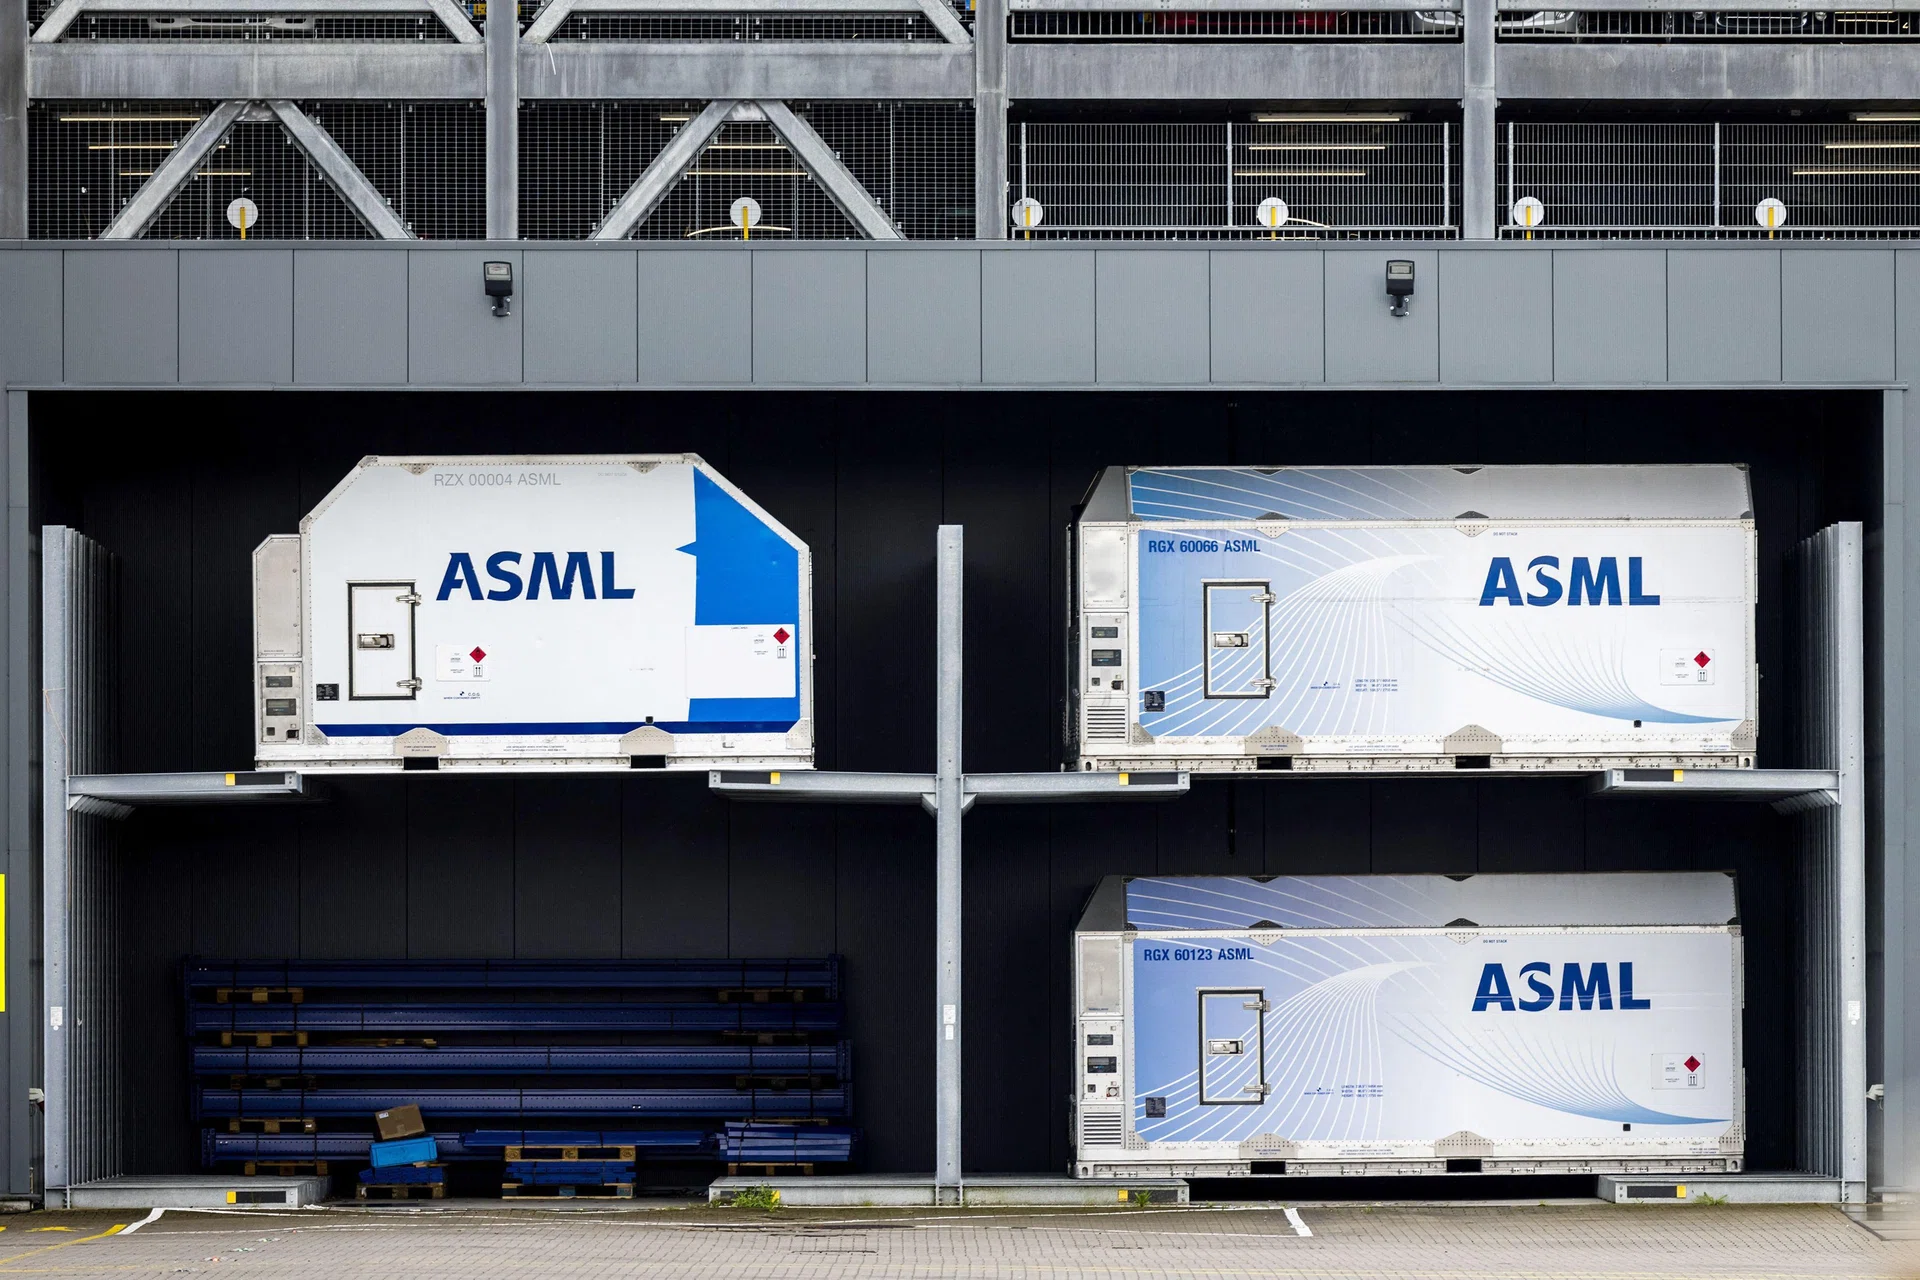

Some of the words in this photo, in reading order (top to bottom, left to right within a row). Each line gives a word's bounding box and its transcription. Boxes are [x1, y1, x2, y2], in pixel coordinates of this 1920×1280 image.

[434, 473, 464, 487] RZX
[468, 473, 513, 487] 00004
[517, 472, 561, 486] ASML
[1148, 540, 1175, 553] RGX
[1179, 540, 1219, 553] 60066
[1223, 539, 1261, 553] ASML
[436, 550, 636, 602] ASML
[1478, 555, 1661, 607] ASML
[1143, 948, 1170, 961] RGX
[1174, 948, 1213, 961] 60123
[1217, 947, 1255, 960] ASML
[1471, 961, 1651, 1012] ASML
